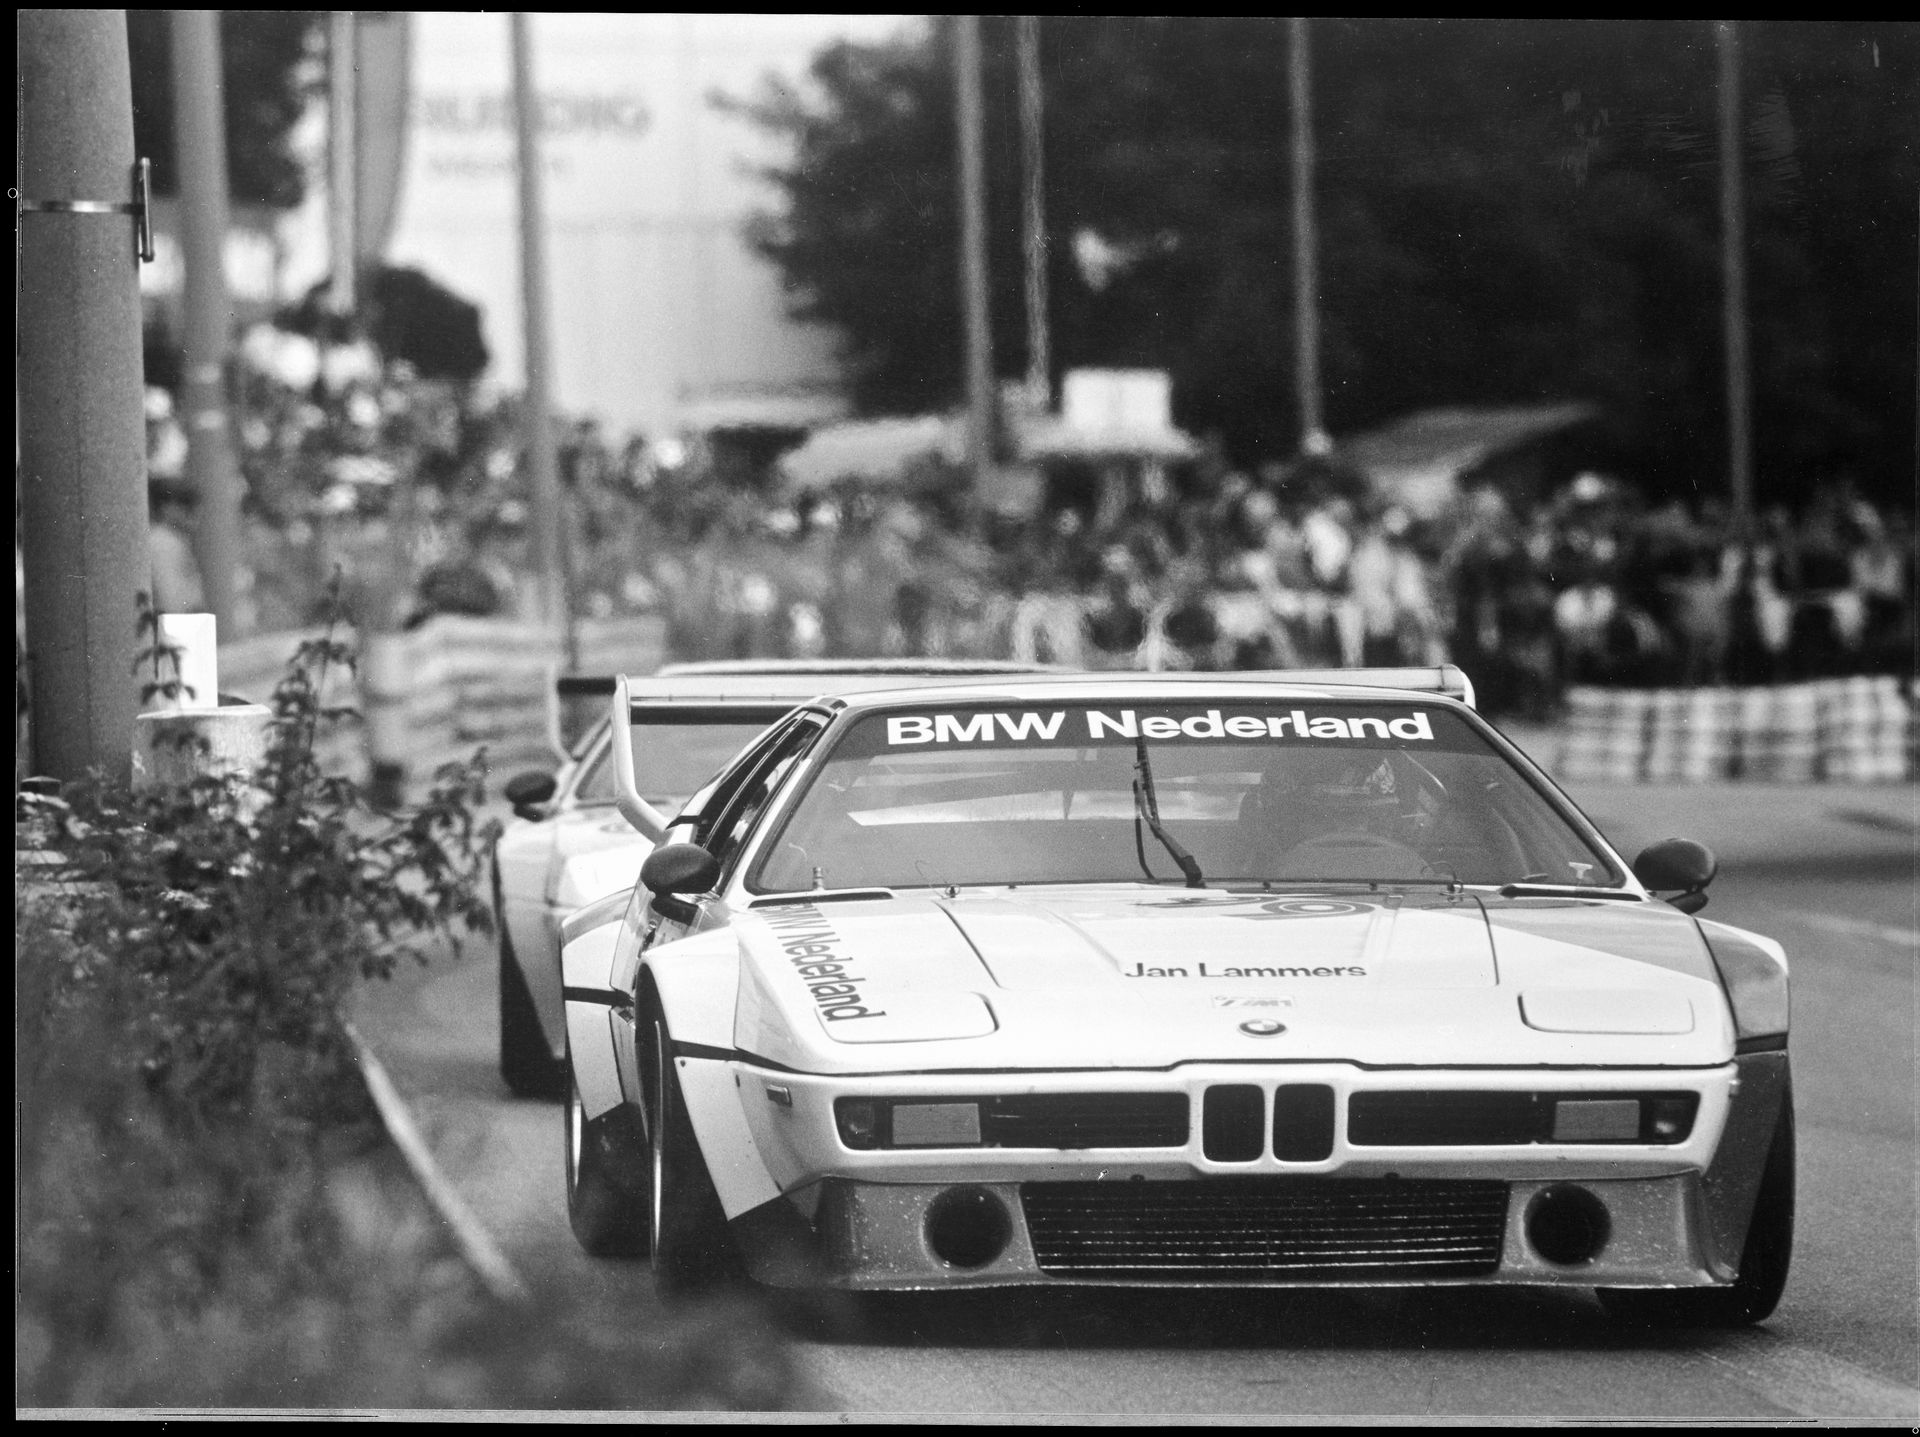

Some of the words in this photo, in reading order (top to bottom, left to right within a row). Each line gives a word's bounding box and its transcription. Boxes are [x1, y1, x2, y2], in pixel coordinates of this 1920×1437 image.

[887, 712, 1066, 745] BMW
[1088, 710, 1435, 740] Nederland
[777, 931, 888, 1022] Nederland
[1124, 962, 1189, 978] Jan
[1198, 962, 1367, 978] Lammers
